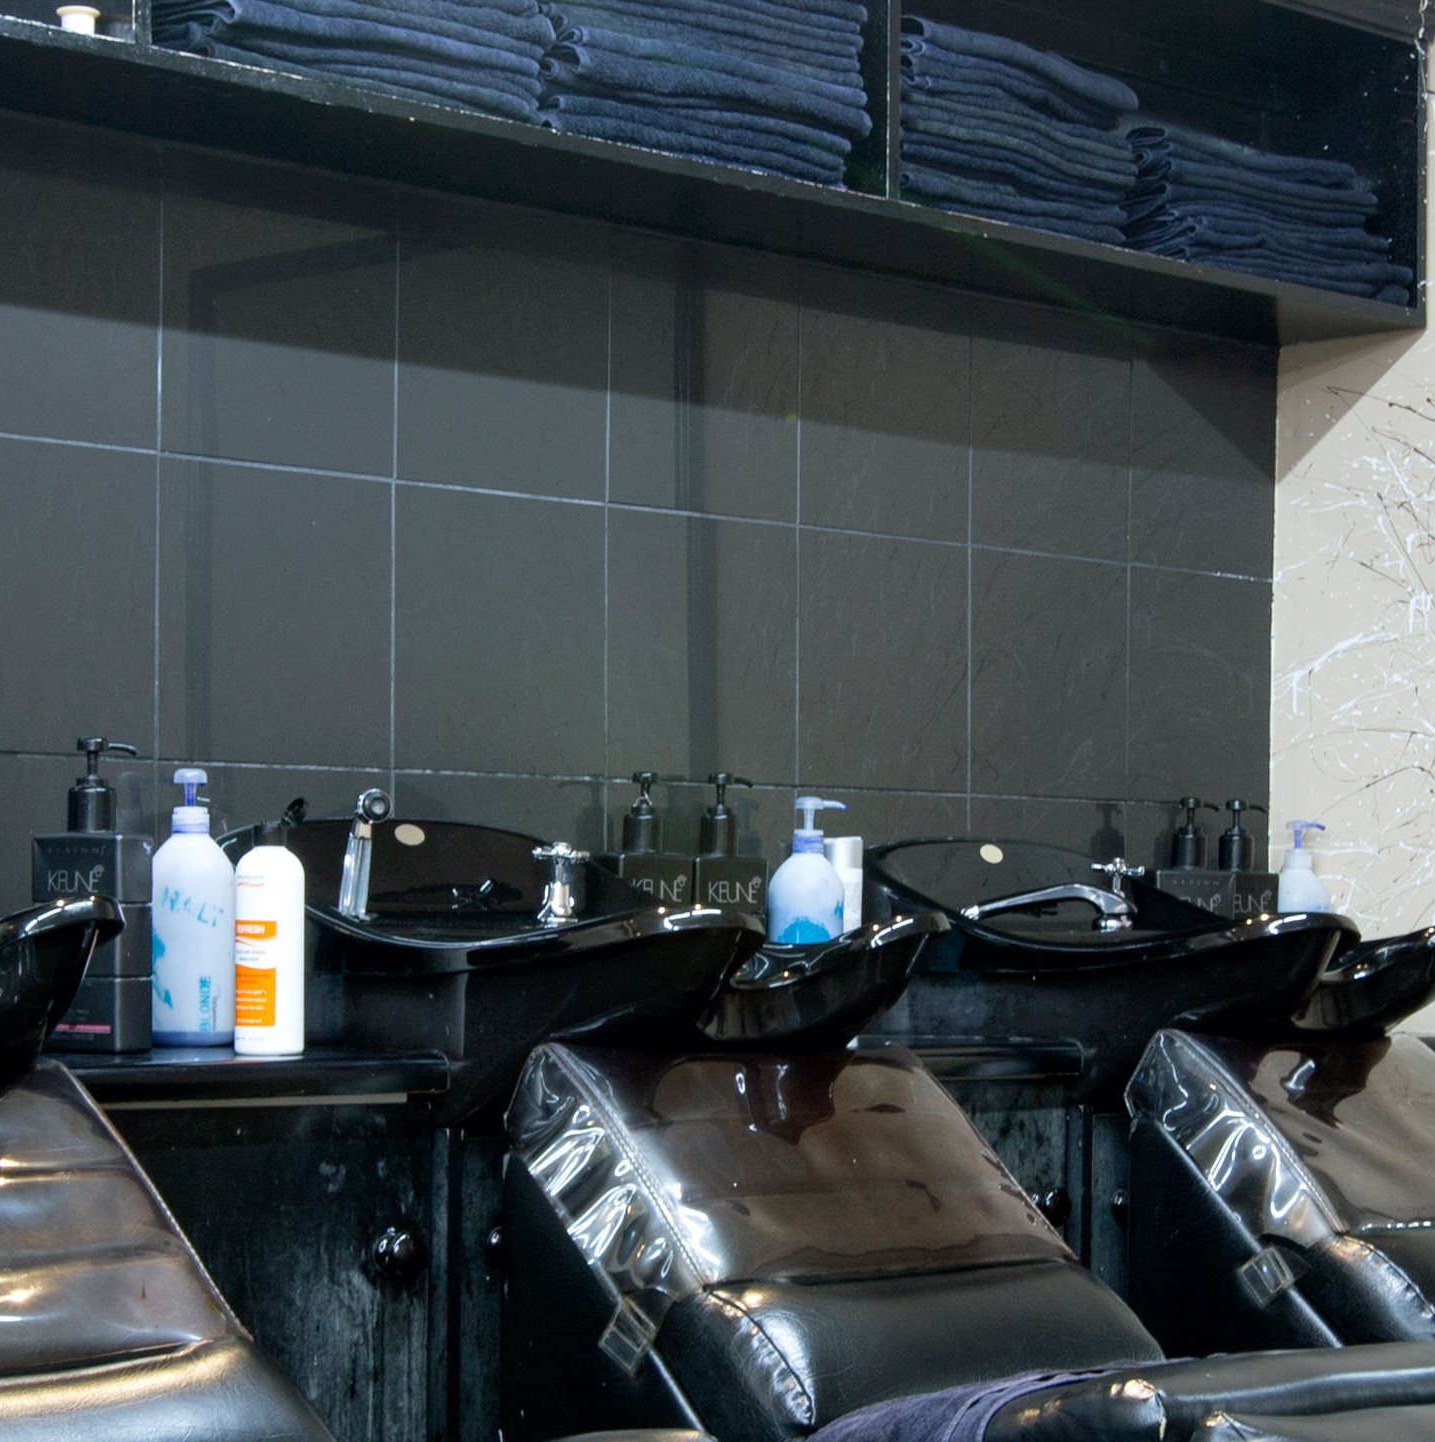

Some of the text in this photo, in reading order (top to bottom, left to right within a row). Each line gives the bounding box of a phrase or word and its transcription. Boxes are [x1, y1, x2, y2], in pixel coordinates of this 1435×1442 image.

[47, 868, 101, 893] KEUNE
[708, 880, 758, 904] KEUNE
[1233, 894, 1269, 913] EUNE
[199, 975, 211, 1032] BLONDE
